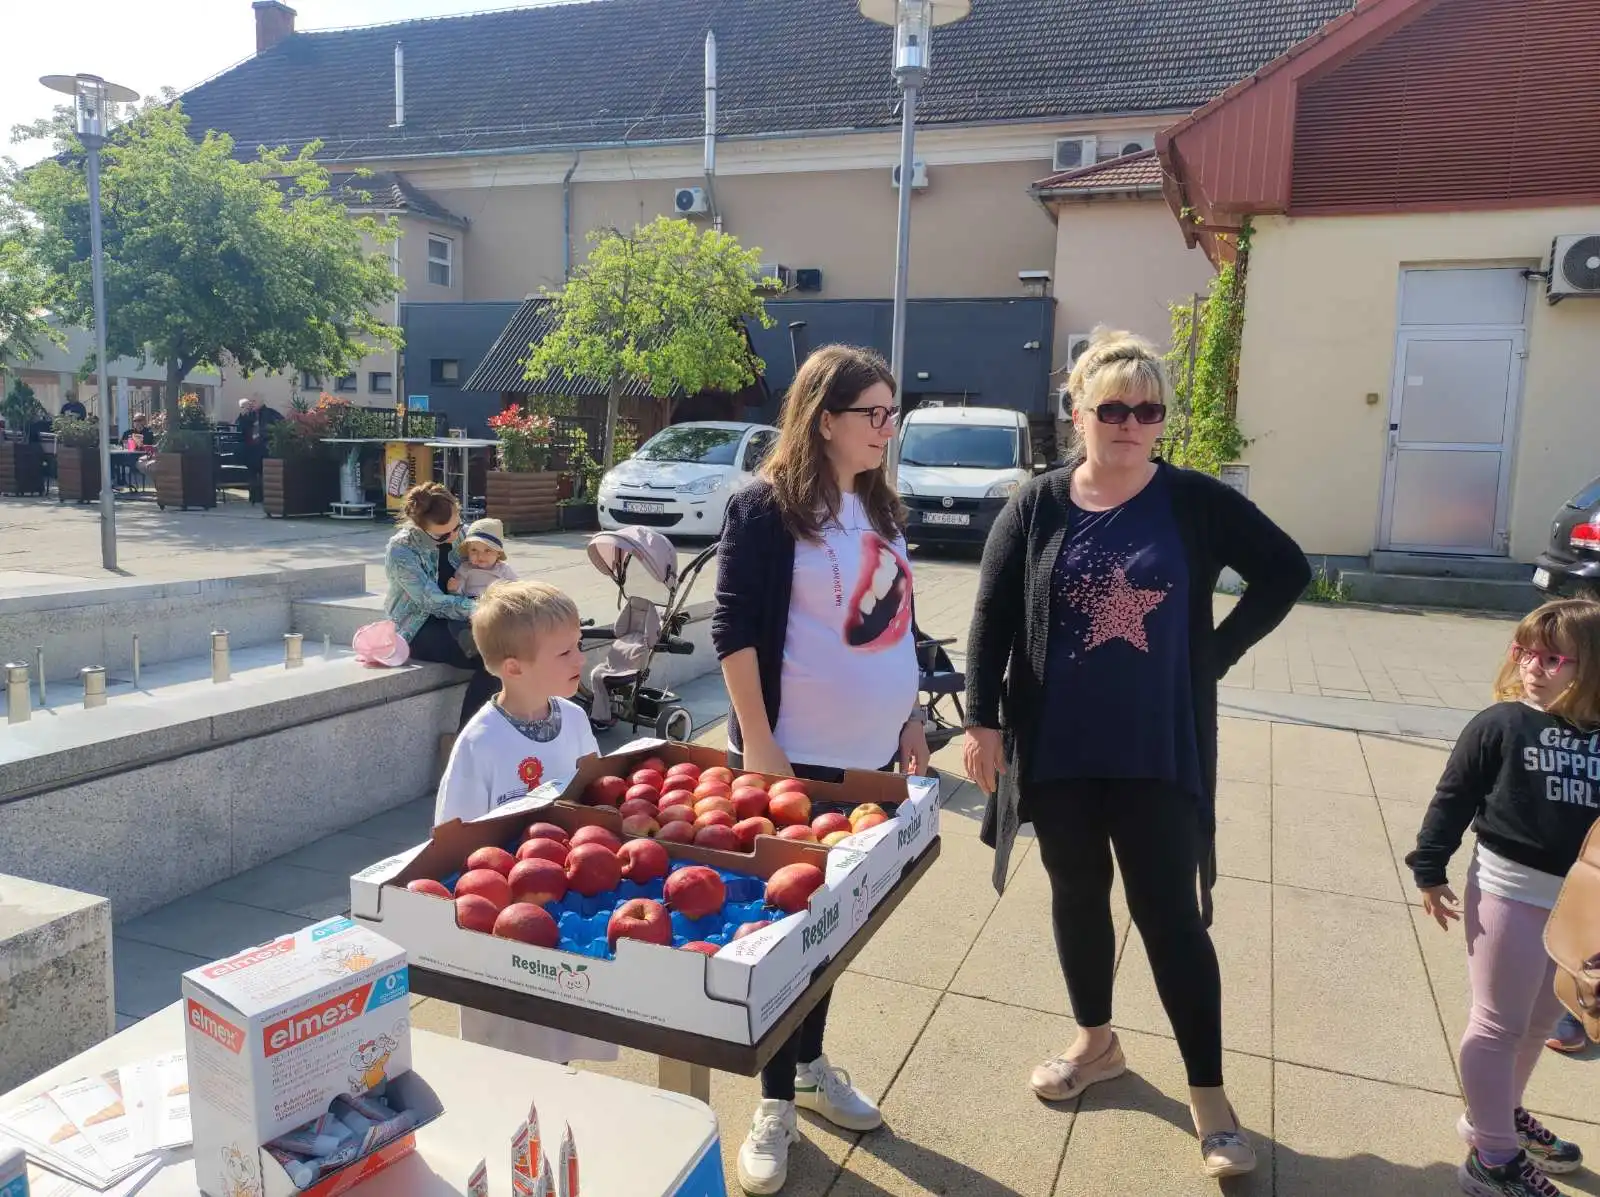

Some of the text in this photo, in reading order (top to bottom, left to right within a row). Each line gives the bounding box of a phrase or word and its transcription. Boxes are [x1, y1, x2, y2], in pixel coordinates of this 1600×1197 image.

[1546, 776, 1600, 809] GIRL
[897, 813, 923, 852] Regina
[800, 901, 840, 956] Regina
[211, 941, 290, 977] elmex
[511, 954, 558, 978] Regina
[191, 1005, 238, 1051] elmex
[270, 997, 357, 1049] elmex
